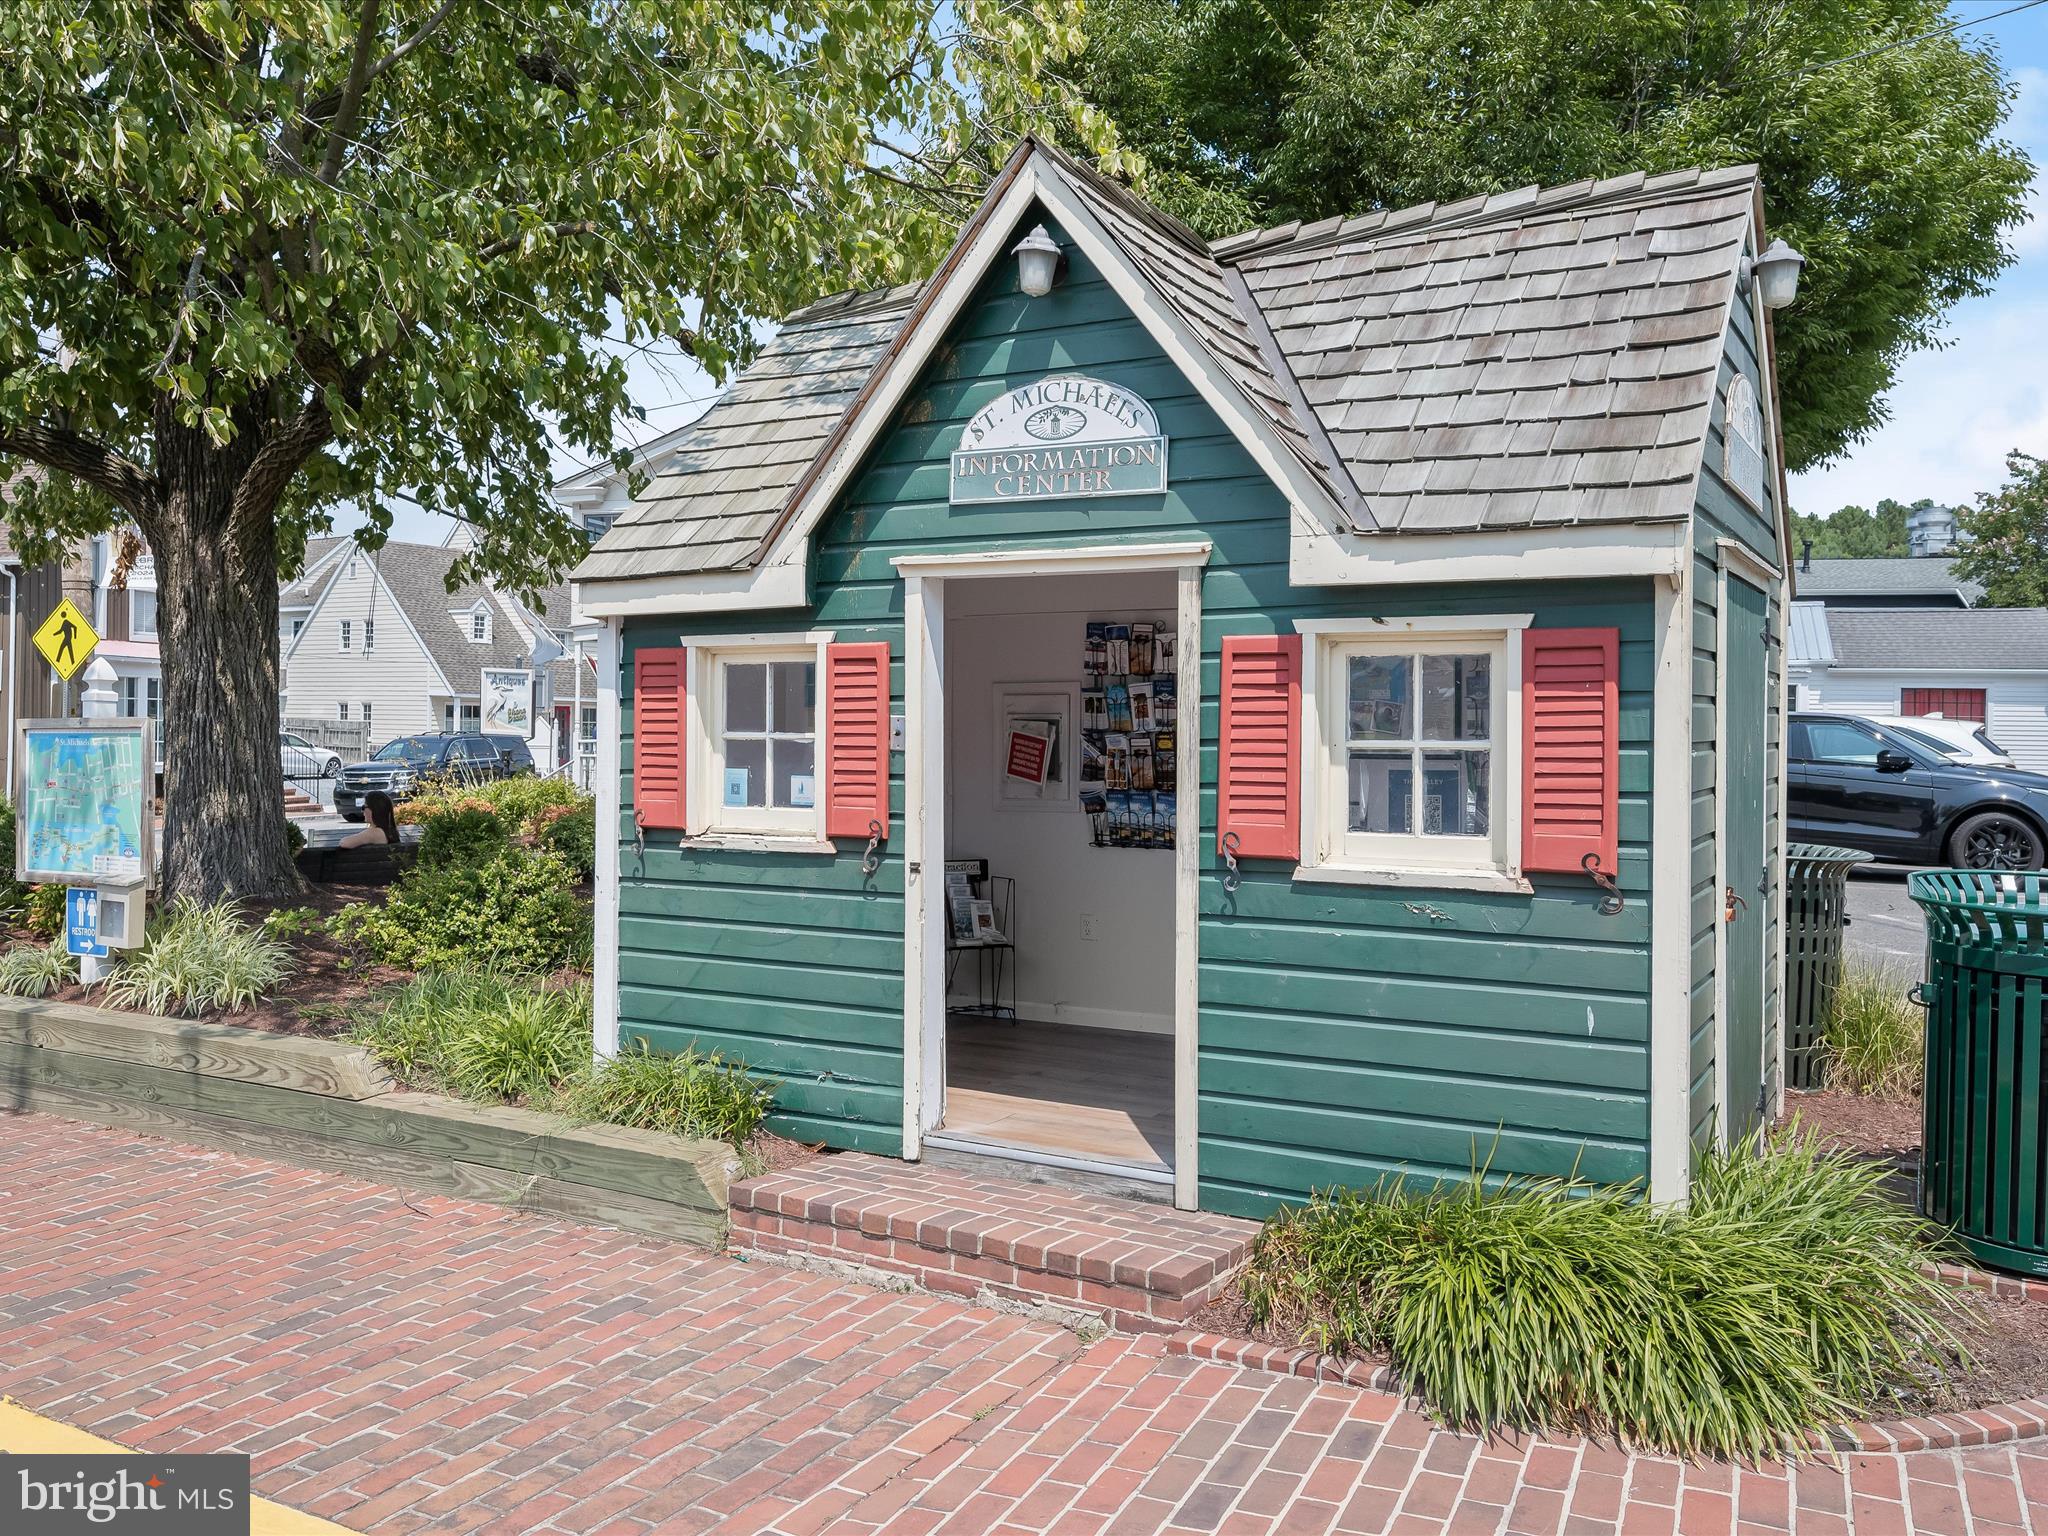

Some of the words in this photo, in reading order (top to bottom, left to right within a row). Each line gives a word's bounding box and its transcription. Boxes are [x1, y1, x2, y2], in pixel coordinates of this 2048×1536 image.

[969, 408, 1003, 444] ST.
[958, 444, 1157, 477] INFORMATION
[993, 470, 1112, 496] CENTER
[489, 673, 526, 687] Antiques
